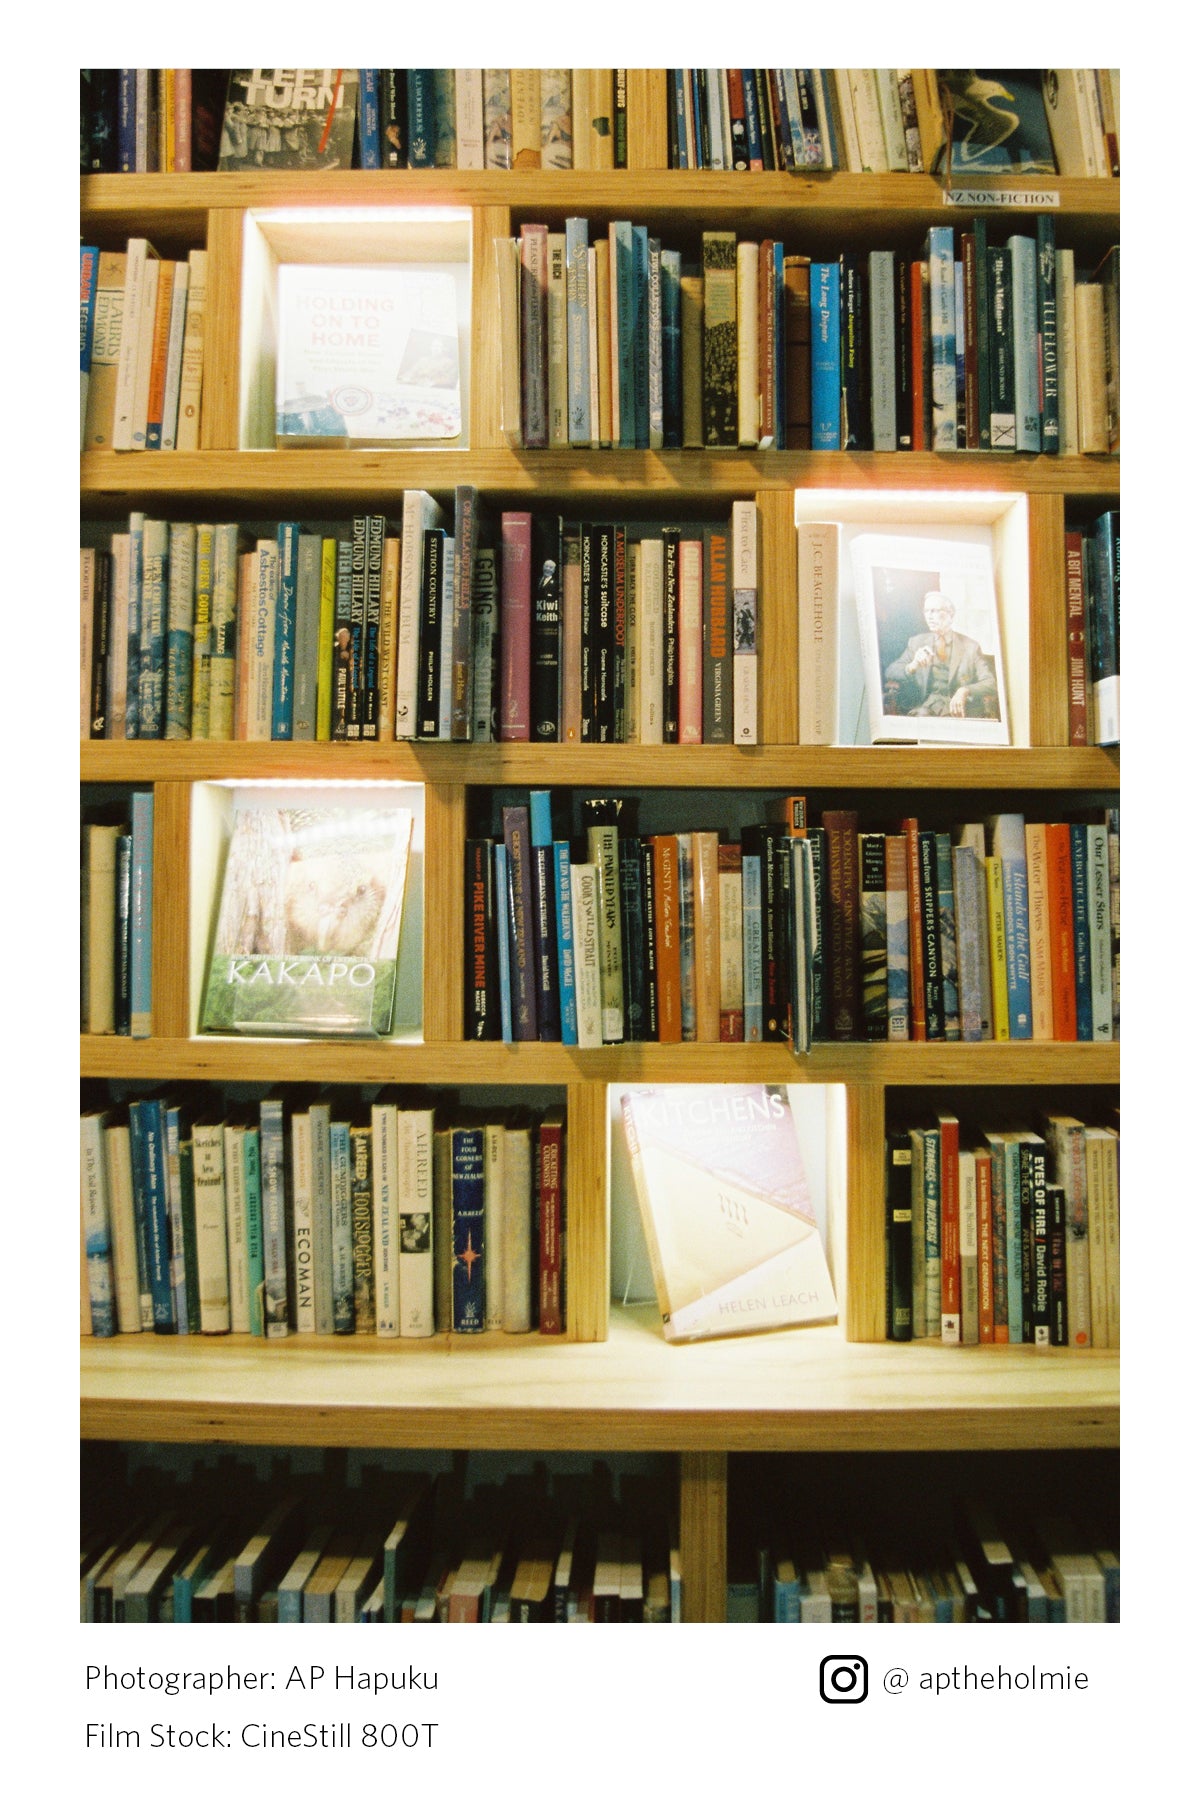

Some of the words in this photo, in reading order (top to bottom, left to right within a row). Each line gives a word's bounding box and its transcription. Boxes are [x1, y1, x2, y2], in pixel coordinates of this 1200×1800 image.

[240, 81, 344, 110] TURN
[967, 193, 1055, 204] NON-FICTION
[552, 249, 562, 262] THE
[651, 252, 659, 273] KIWI
[81, 253, 93, 300] URBAN
[552, 263, 562, 280] RICH
[821, 267, 830, 283] The
[297, 297, 394, 312] HOLDING
[819, 286, 830, 308] Long
[80, 301, 90, 352] LEGEND
[94, 296, 108, 356] EDMOND
[107, 297, 125, 357] LAURIS
[312, 314, 342, 329] ON
[352, 315, 380, 329] TO
[819, 310, 829, 343] Dispute
[1043, 300, 1056, 326] TUI
[159, 307, 169, 361] OCTOBER
[312, 332, 380, 347] HOME
[1044, 331, 1057, 398] FLOWER
[740, 511, 751, 533] First
[199, 532, 211, 554] OUR
[352, 519, 366, 570] EDMUND
[369, 519, 382, 570] EDMUND
[429, 538, 437, 574] STATION
[667, 544, 675, 558] The
[741, 536, 748, 546] to
[812, 542, 822, 562] J.C.
[152, 555, 162, 583] OPEN
[339, 541, 351, 574] AFTER
[601, 534, 609, 589] HORNCASTLE'S
[616, 541, 625, 585] MUSEUM
[667, 559, 675, 577] First
[710, 535, 726, 582] ALLAN
[740, 548, 750, 574] Care
[1068, 560, 1080, 576] BIT
[198, 559, 210, 589] OPEN
[258, 549, 270, 606] Asbestos
[475, 558, 493, 615] GOING
[667, 578, 675, 592] New
[151, 587, 161, 636] COUNTRY
[337, 576, 352, 620] EVEREST
[351, 574, 364, 624] HILLARY
[367, 574, 381, 624] HILLARY
[428, 577, 437, 618] COUNTRY
[536, 600, 558, 611] Kiwi
[600, 591, 610, 627] suitcase
[813, 566, 823, 644] BEAGLEHOLE
[1068, 578, 1081, 617] MENTAL
[198, 593, 210, 644] COUNTRY
[536, 612, 558, 621] Keith
[616, 587, 625, 647] UNDERFOOT
[667, 594, 675, 634] Zealanders
[710, 585, 726, 658] HUBBARD
[216, 613, 226, 654] CALLING
[256, 608, 268, 658] Cottage
[383, 621, 391, 646] WILD
[666, 638, 674, 655] Philip
[382, 649, 390, 675] WEST
[456, 661, 465, 678] Janet
[600, 648, 608, 671] Graeme
[667, 655, 675, 686] Houghton
[1071, 657, 1083, 677] JIMI
[168, 649, 176, 712] HENDERSON
[337, 668, 347, 685] PAUL
[455, 680, 464, 700] Holm
[600, 672, 608, 701] Horncastle
[714, 662, 722, 697] VIRGINIA
[337, 687, 346, 709] LITTLE
[381, 677, 389, 707] COAST
[1071, 679, 1085, 706] HUNT
[714, 698, 722, 722] GREEN
[603, 834, 613, 851] THE
[922, 840, 931, 865] Echoes
[1094, 837, 1105, 861] Our
[604, 854, 614, 896] PAINTED
[662, 848, 671, 891] McGINTY
[831, 829, 840, 903] GOVERNMENT
[923, 865, 931, 884] from
[1095, 863, 1105, 899] Lesser
[473, 881, 485, 912] PIKE
[581, 875, 593, 906] COOK'S
[1014, 872, 1026, 916] Islands
[584, 907, 593, 937] WILD
[606, 897, 616, 929] YEARS
[924, 887, 934, 931] SKIPPERS
[1096, 901, 1106, 930] Stars
[474, 913, 485, 952] RIVER
[1016, 918, 1027, 931] of
[585, 938, 596, 967] STRAIT
[927, 933, 937, 977] CANYON
[1017, 933, 1027, 950] the
[227, 961, 376, 987] KAKAPO
[474, 955, 485, 988] MINE
[1017, 953, 1029, 983] Gulf
[640, 1092, 786, 1128] KITCHENS
[148, 1131, 155, 1141] No
[339, 1133, 347, 1153] THE
[147, 1143, 156, 1172] Ordinary
[269, 1147, 277, 1164] THE
[543, 1145, 551, 1188] COLONISTS
[550, 1143, 558, 1189] CRICKETING
[925, 1137, 937, 1182] STRANGERS
[232, 1166, 240, 1193] RIDES
[269, 1166, 277, 1193] SNOW
[1034, 1156, 1045, 1186] EYES
[340, 1156, 348, 1227] GUMDIGGERS
[1035, 1190, 1045, 1205] OF
[270, 1195, 278, 1233] FARMER
[926, 1198, 938, 1243] WILDERNESS
[1036, 1208, 1046, 1235] FIRE
[353, 1191, 372, 1278] FOOTSLOGGER
[297, 1228, 312, 1308] ECOMAN
[1036, 1245, 1046, 1277] David
[982, 1262, 990, 1310] GENERATION
[1037, 1279, 1047, 1312] Robie
[718, 1299, 767, 1316] HELEN
[772, 1290, 820, 1309] LEACH
